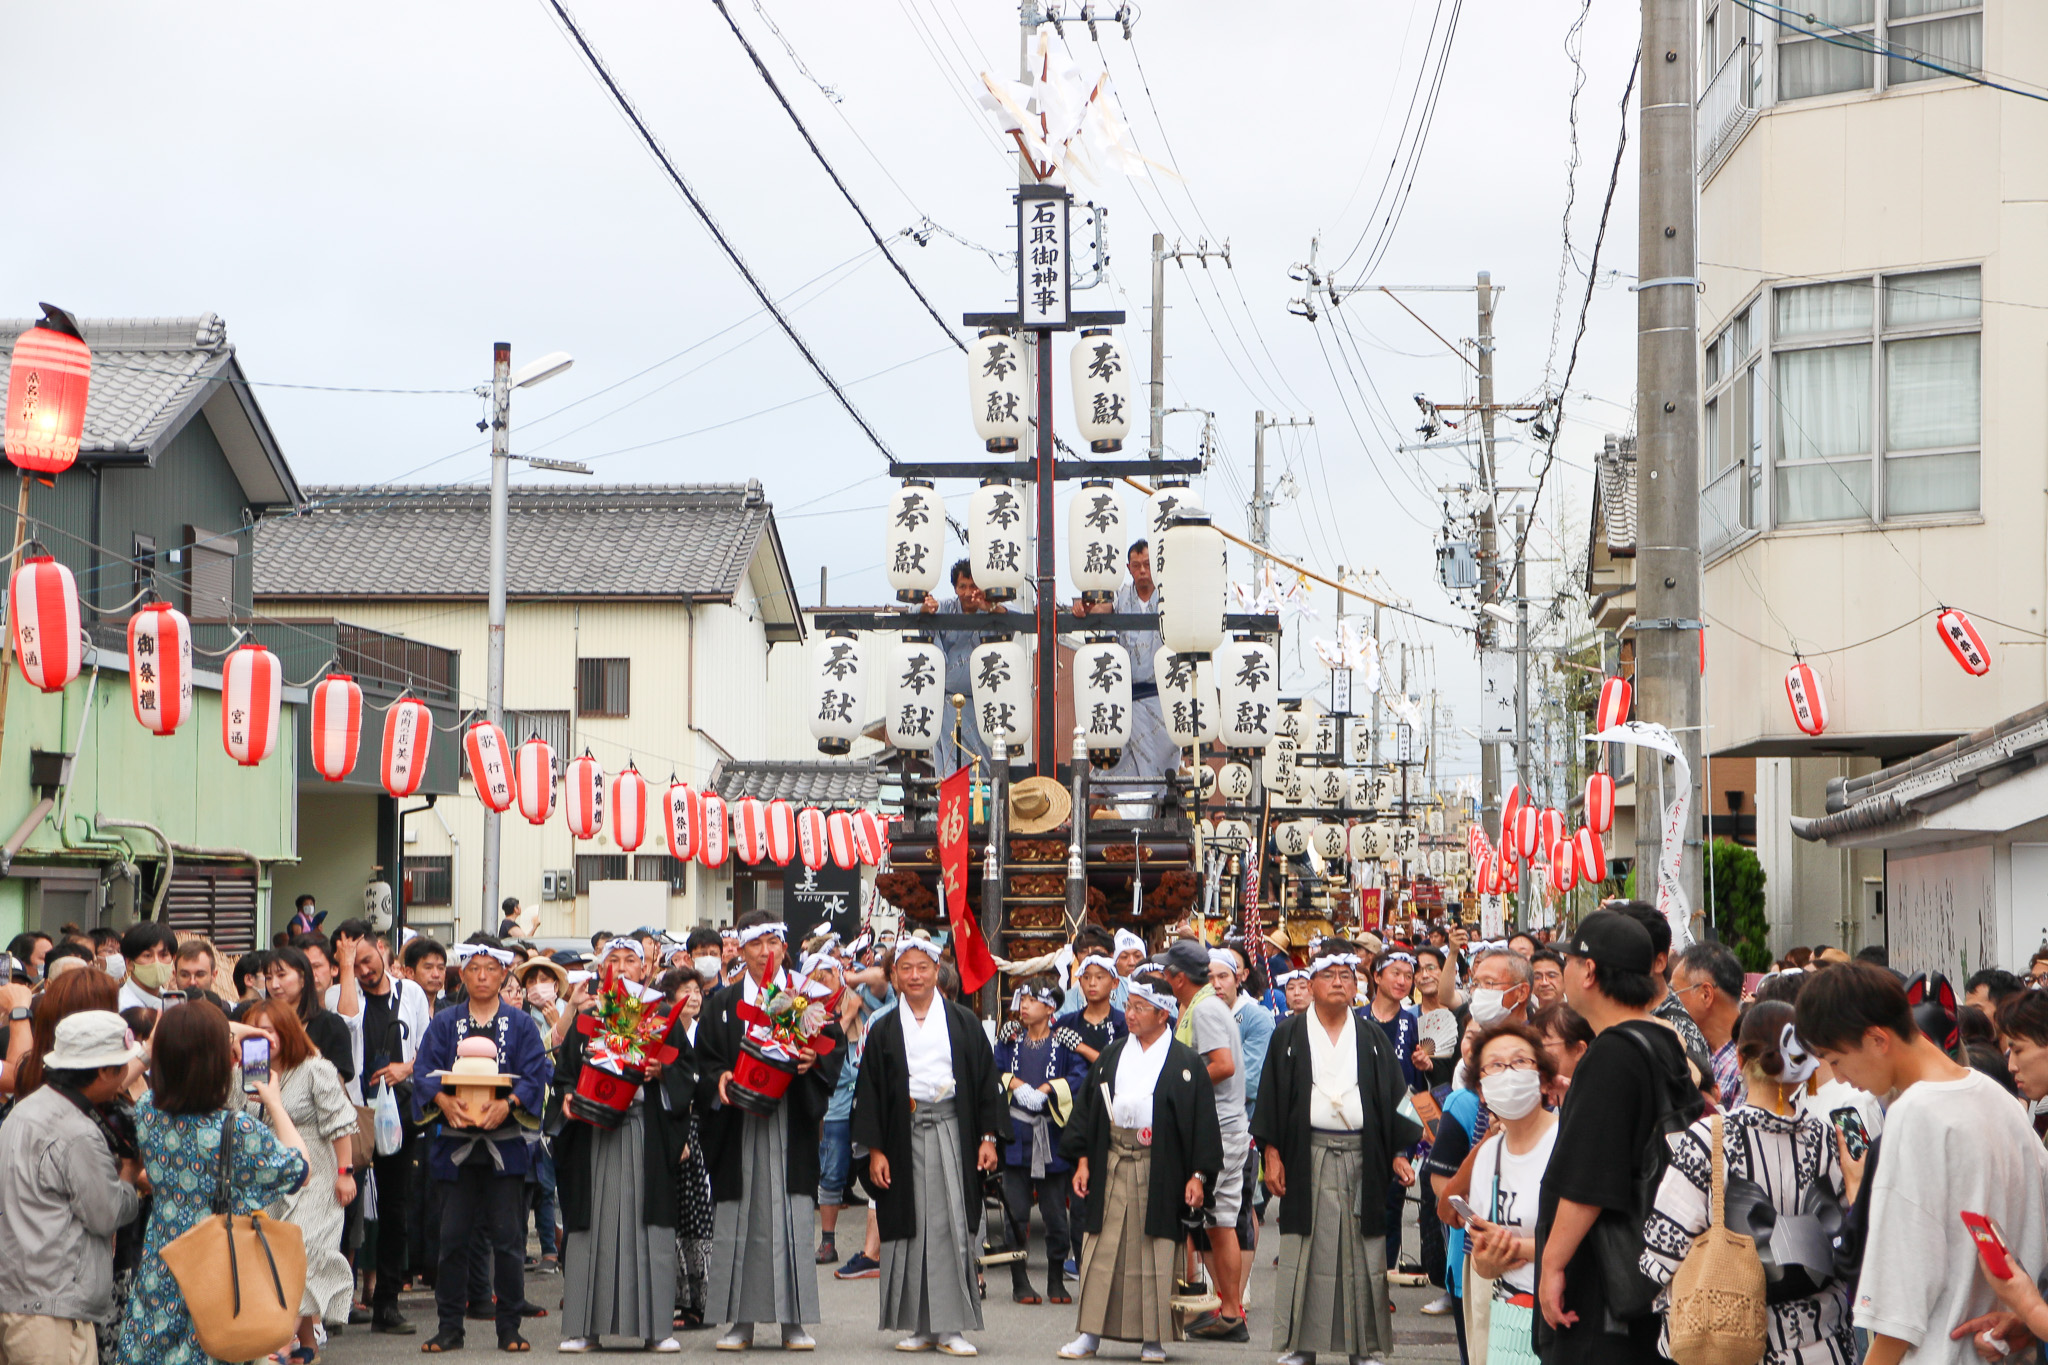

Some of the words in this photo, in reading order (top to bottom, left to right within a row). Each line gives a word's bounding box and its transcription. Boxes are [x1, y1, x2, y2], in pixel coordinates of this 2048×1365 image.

[1029, 201, 1060, 316] 石取御神事
